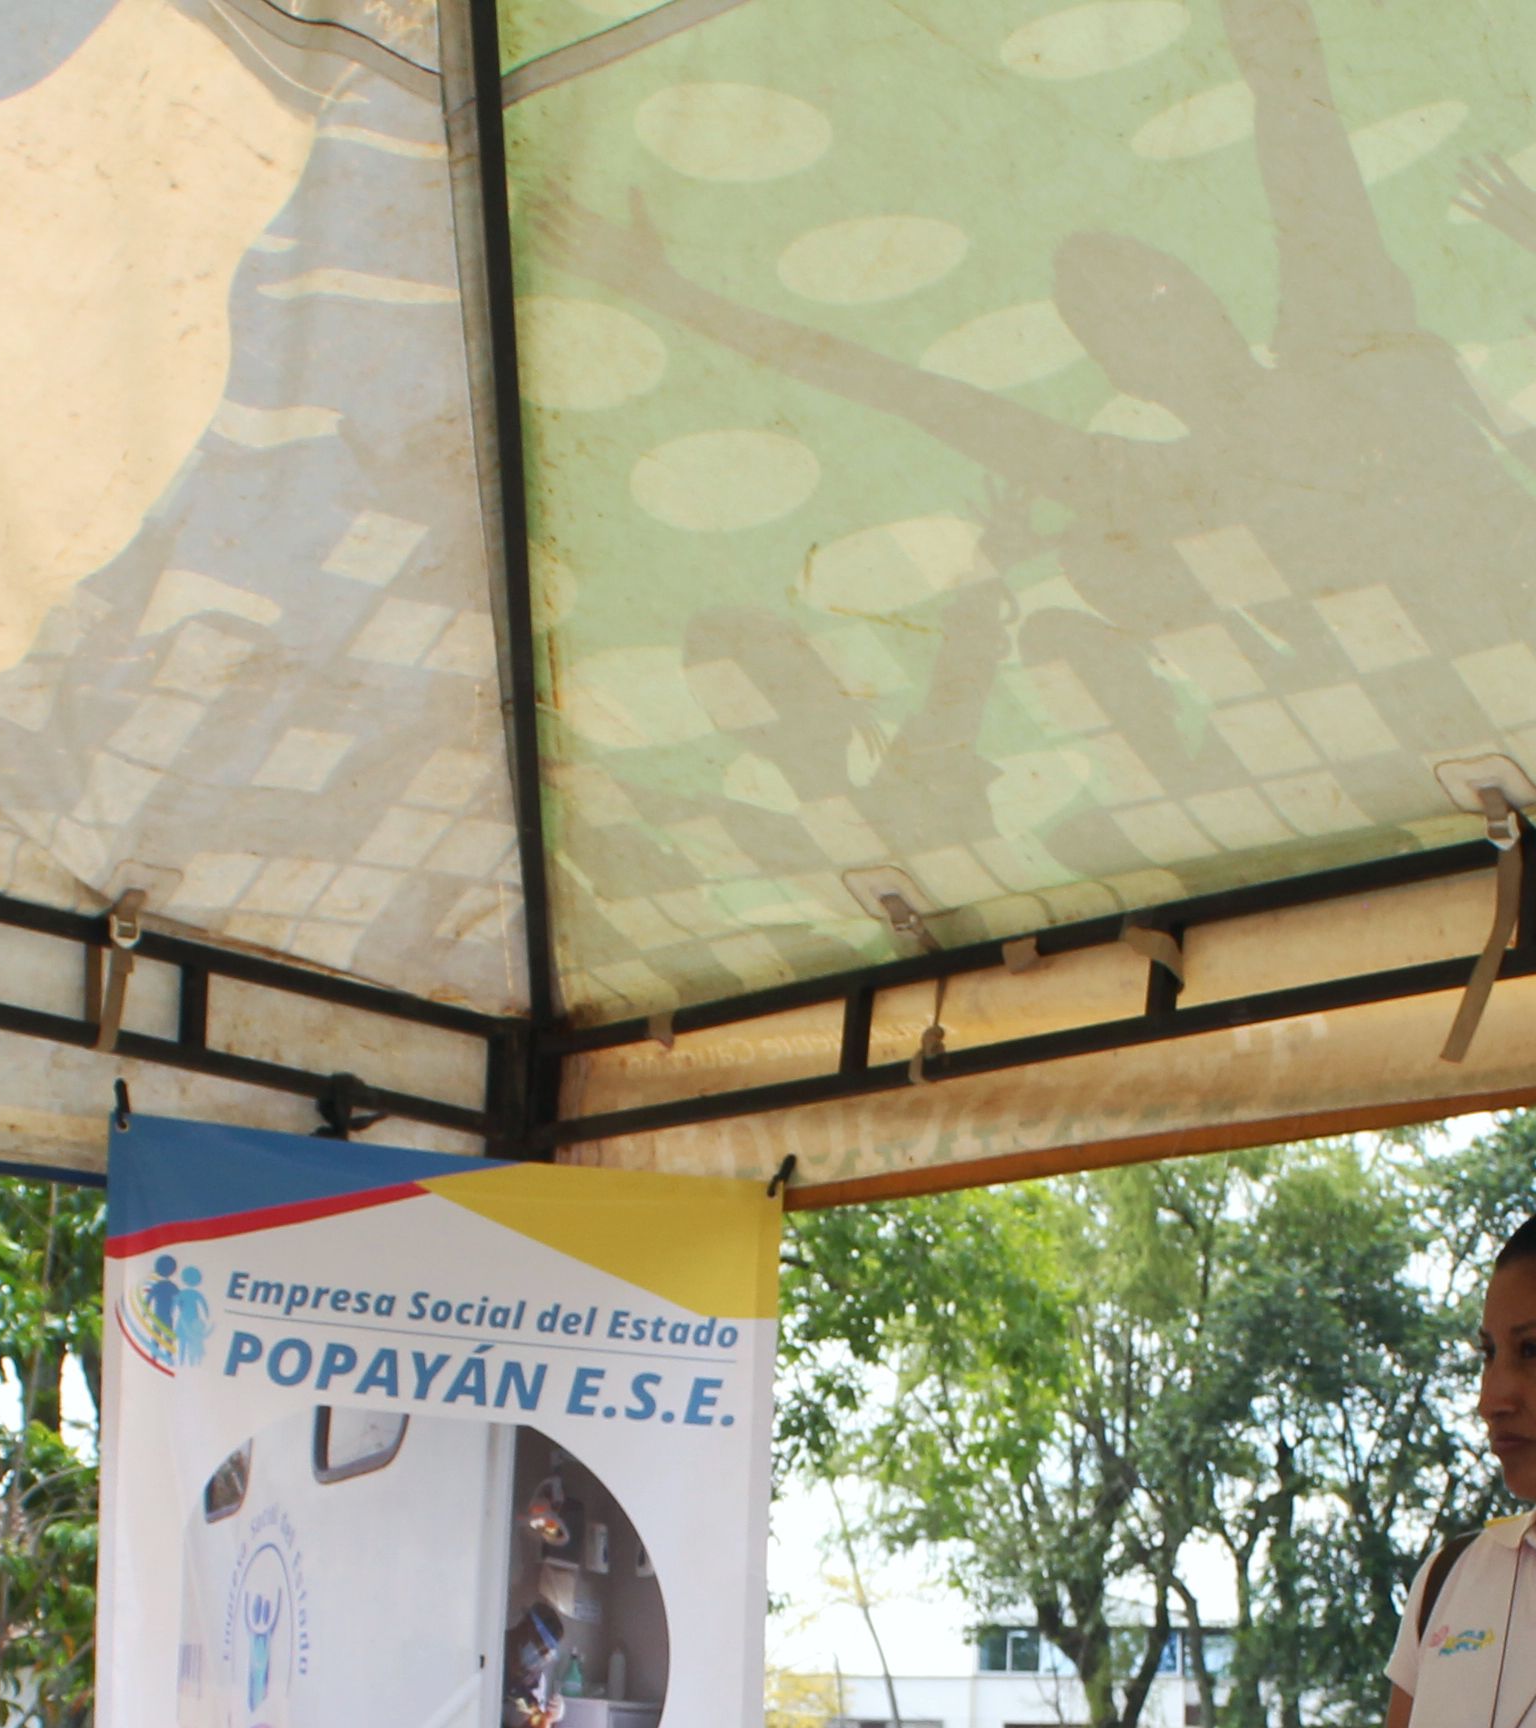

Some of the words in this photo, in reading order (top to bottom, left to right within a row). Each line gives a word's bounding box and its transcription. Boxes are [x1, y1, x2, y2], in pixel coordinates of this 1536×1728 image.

[224, 1270, 398, 1322] Empresa
[407, 1289, 524, 1331] Social
[535, 1299, 598, 1338] del
[606, 1309, 740, 1350] Estado
[223, 1331, 548, 1411] POPAYÁN
[565, 1367, 736, 1428] E.S.E.
